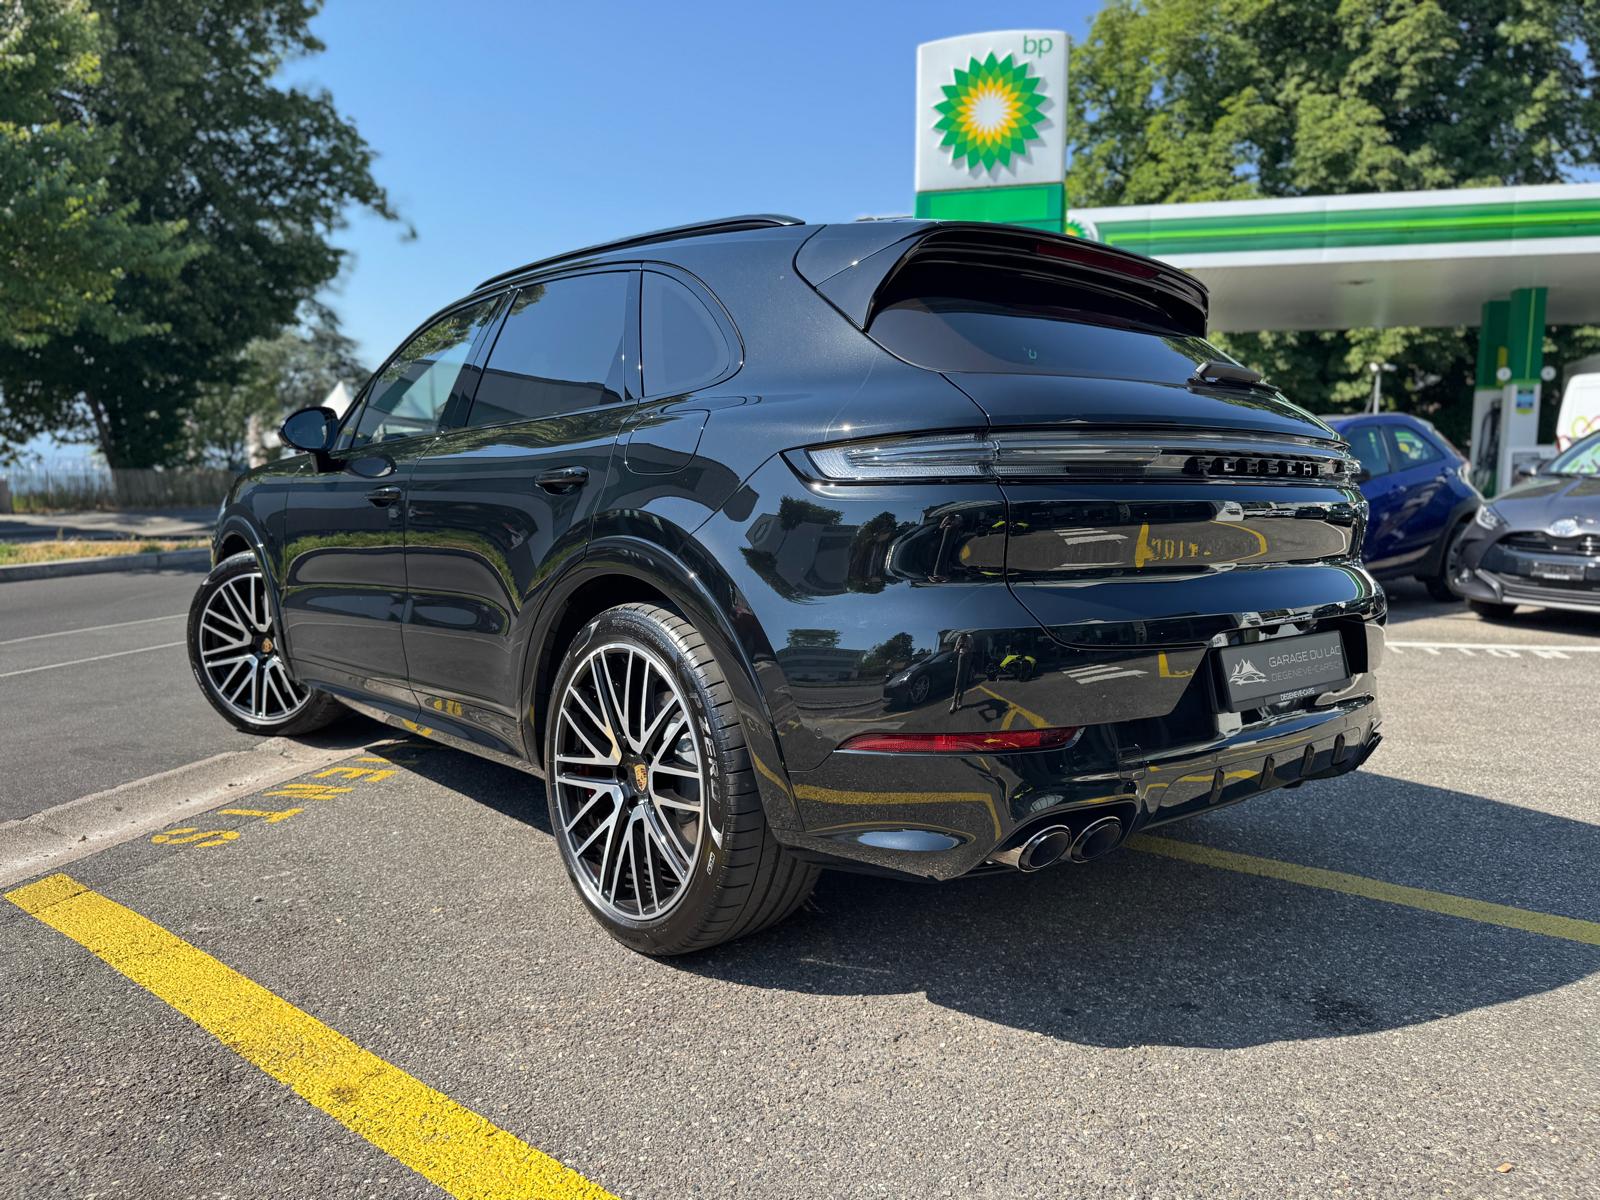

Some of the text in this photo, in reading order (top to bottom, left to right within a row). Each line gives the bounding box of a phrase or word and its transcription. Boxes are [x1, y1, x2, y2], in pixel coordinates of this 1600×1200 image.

[1023, 34, 1053, 58] bp
[1268, 645, 1342, 668] GARAGE DU LAC
